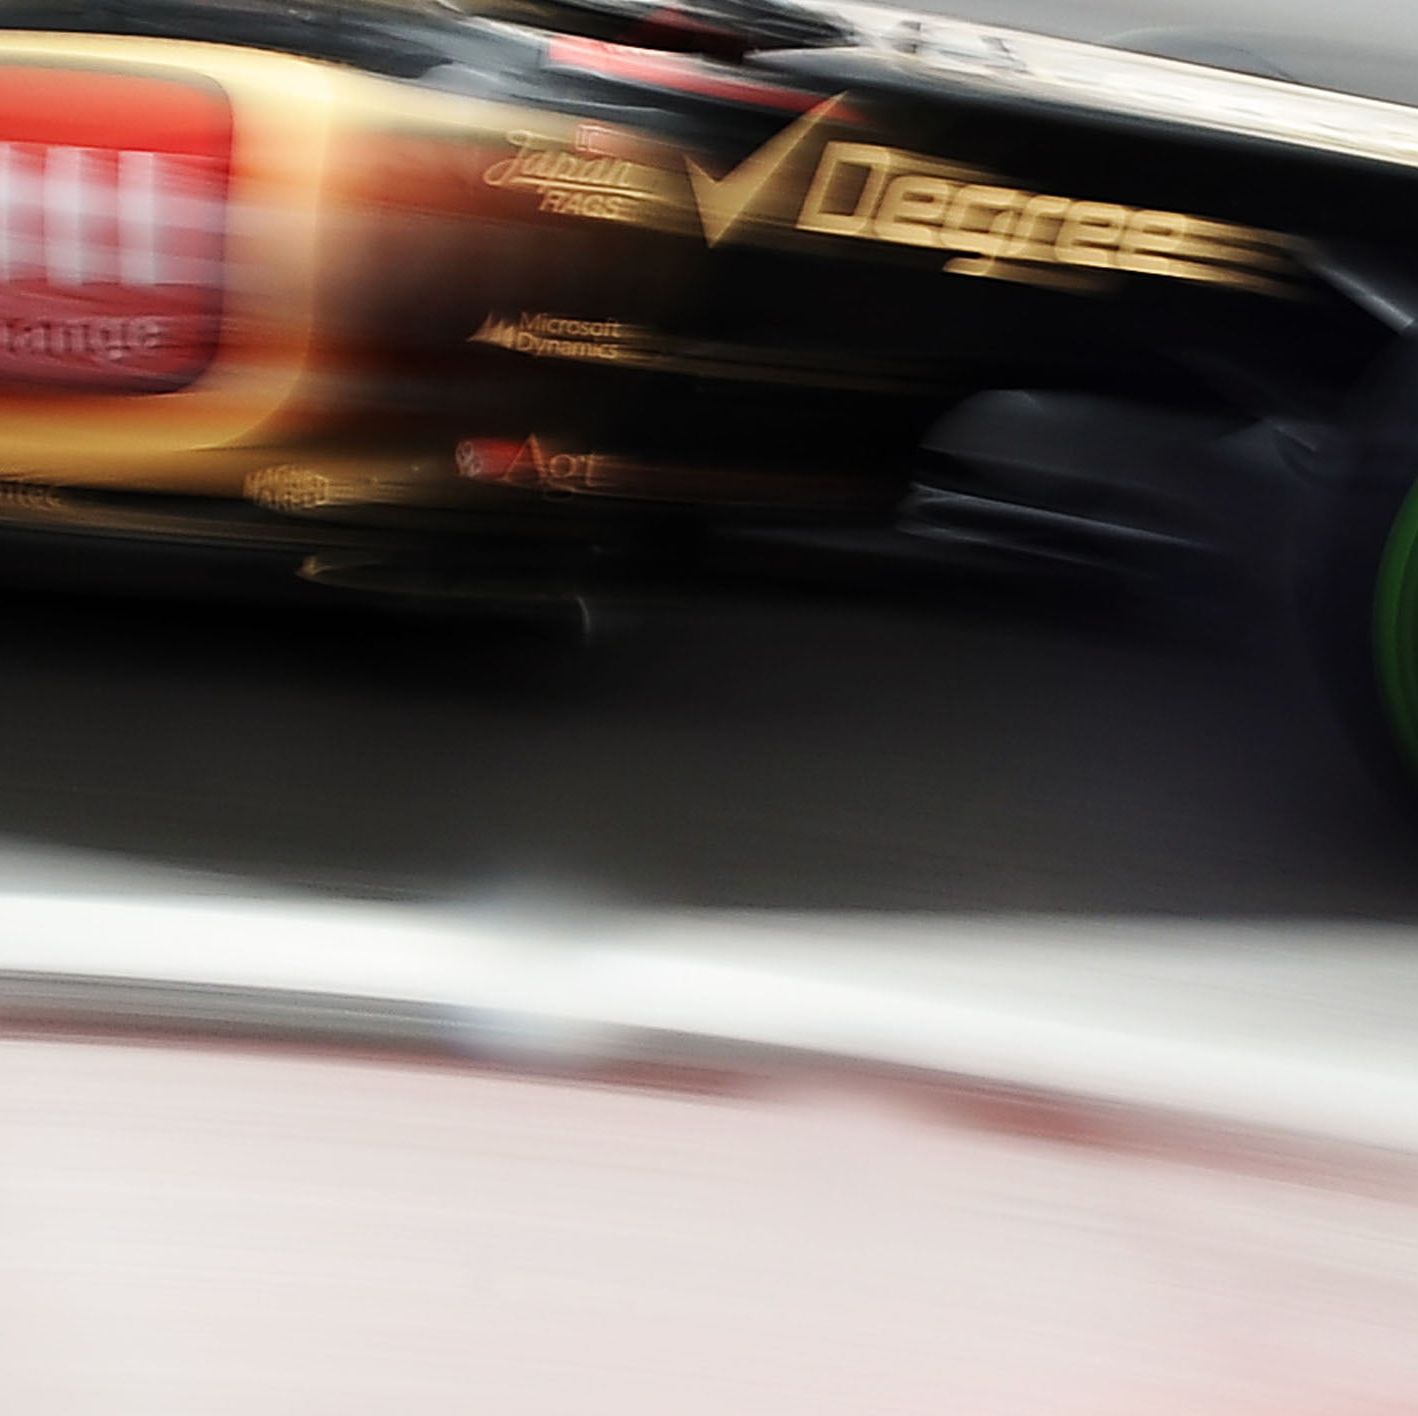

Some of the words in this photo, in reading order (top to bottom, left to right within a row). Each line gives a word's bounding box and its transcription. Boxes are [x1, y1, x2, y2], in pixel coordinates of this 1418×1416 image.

[483, 129, 634, 186] Japan
[795, 141, 1189, 278] Degree
[517, 331, 619, 360] Dynamics
[519, 311, 622, 339] Microsoft
